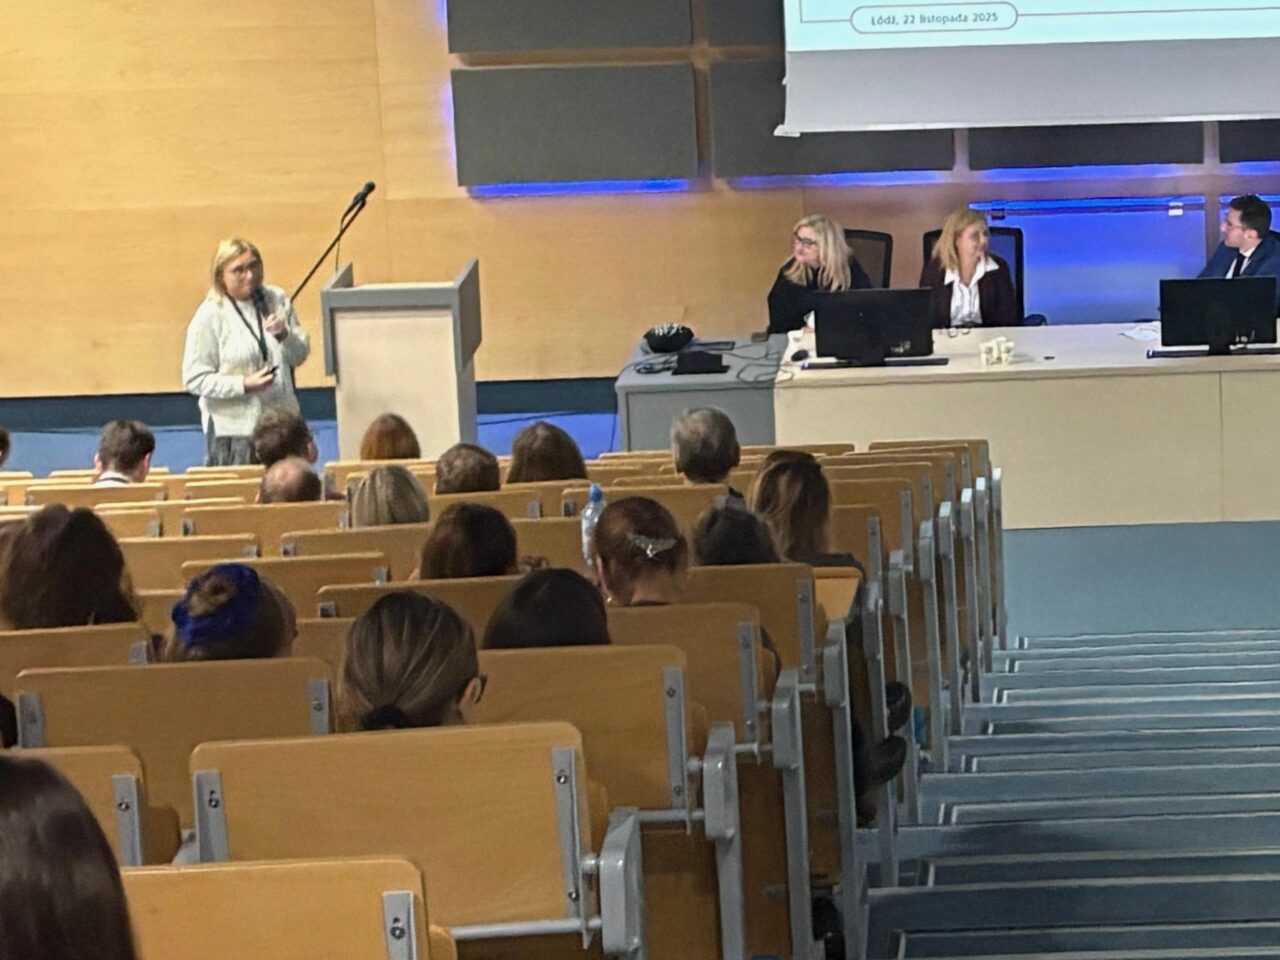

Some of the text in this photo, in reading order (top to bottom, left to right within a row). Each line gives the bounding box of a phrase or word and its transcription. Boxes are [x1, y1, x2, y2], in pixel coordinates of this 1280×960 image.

[903, 14, 915, 24] 22
[920, 13, 968, 25] listopada
[972, 12, 998, 23] 2025
